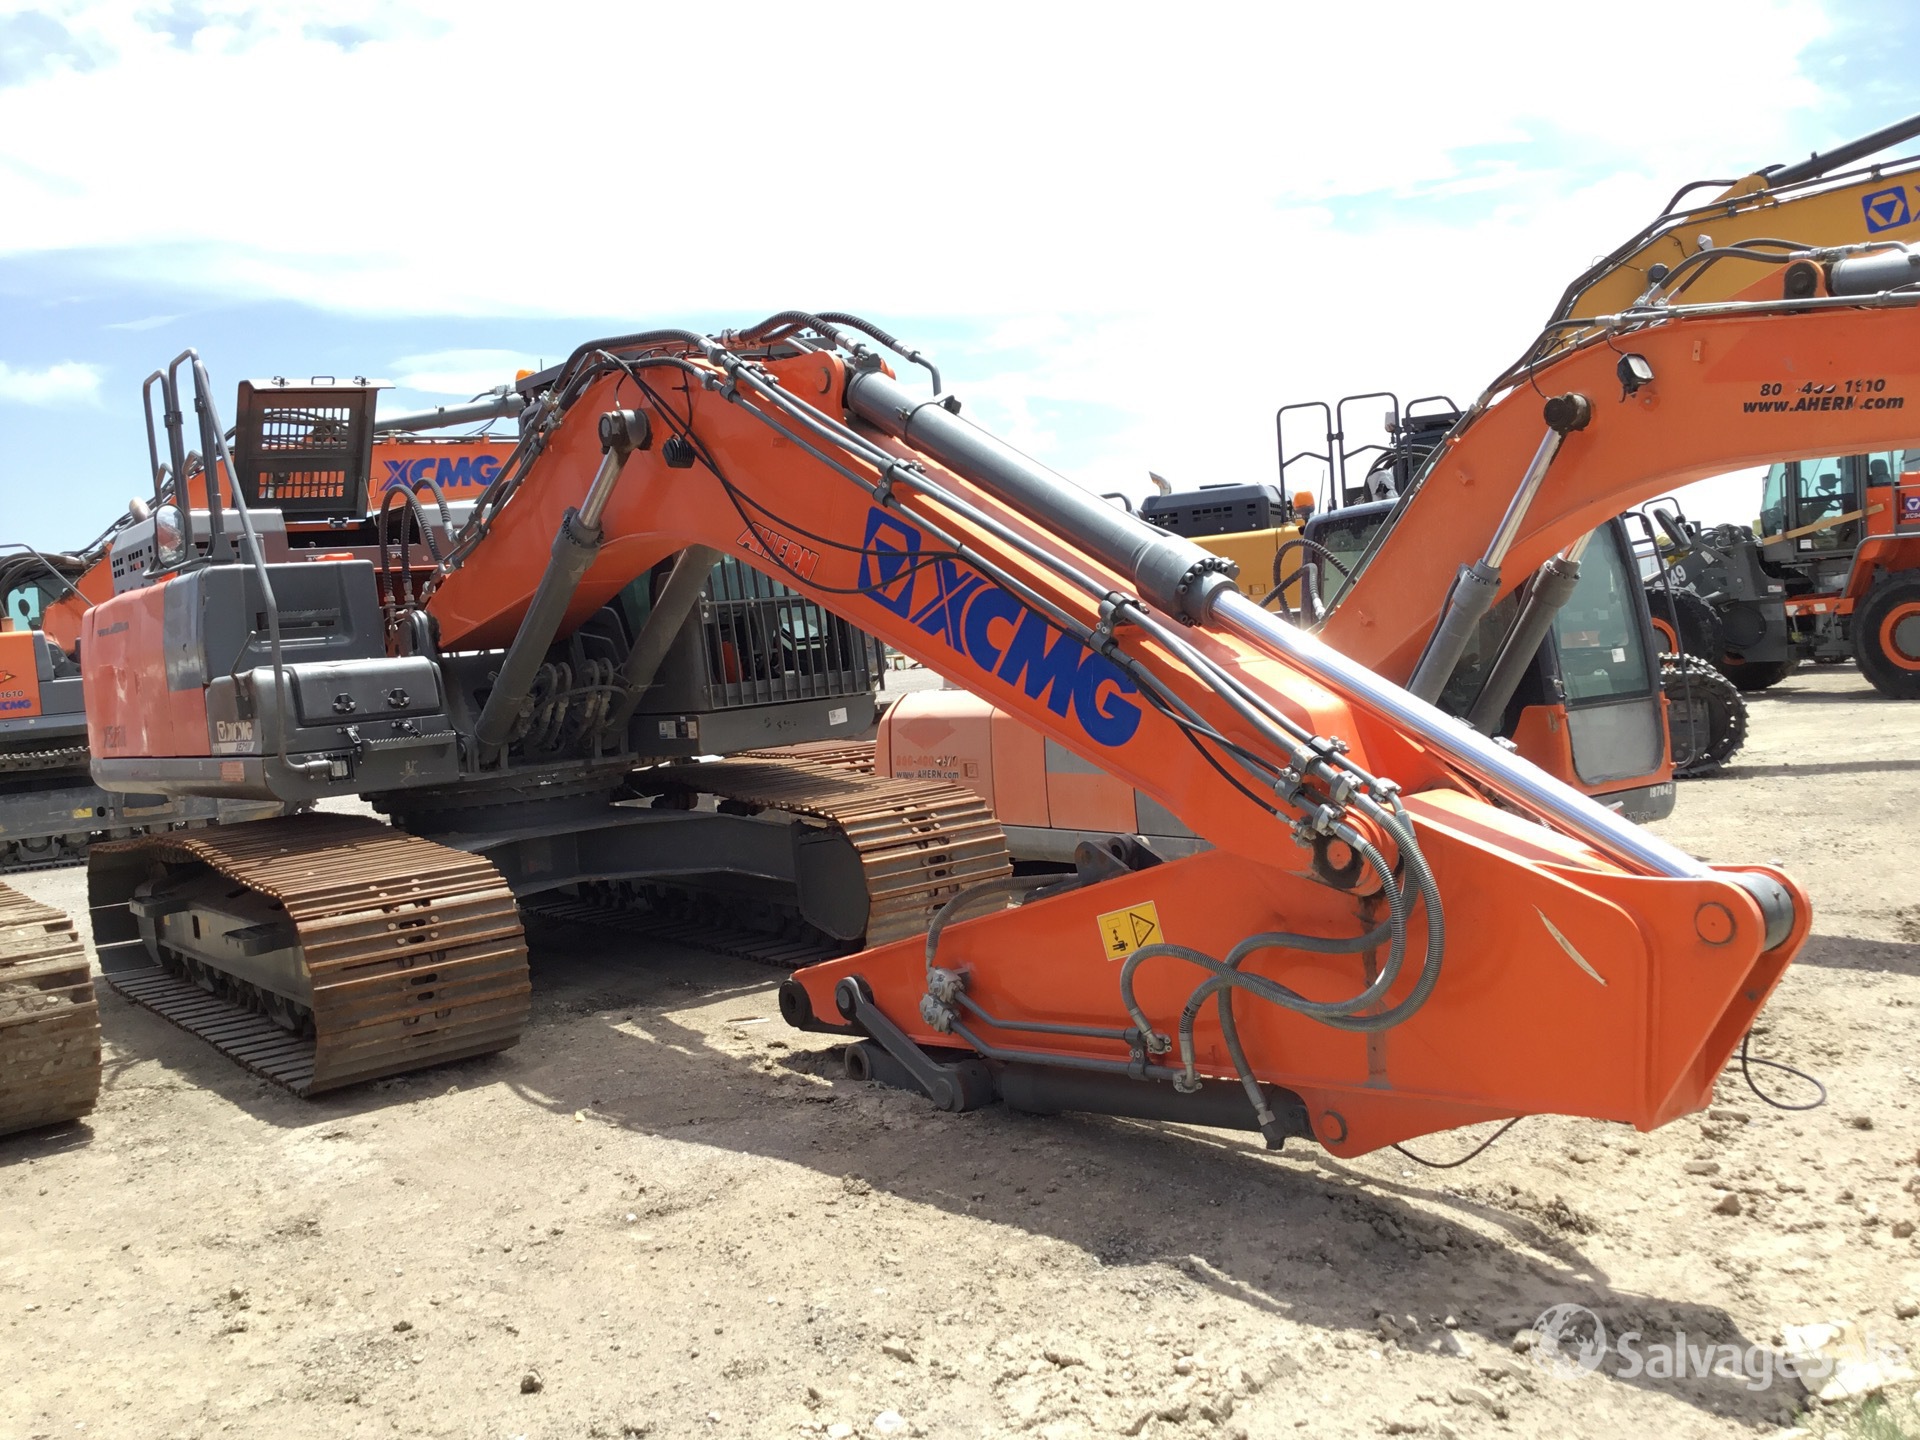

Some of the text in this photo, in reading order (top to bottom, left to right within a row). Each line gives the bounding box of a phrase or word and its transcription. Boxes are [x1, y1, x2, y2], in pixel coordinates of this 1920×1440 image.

[380, 455, 502, 491] XCMG
[737, 522, 819, 581] AHERN
[909, 558, 1142, 747] XCMG
[896, 769, 959, 779] www.AHERN.com
